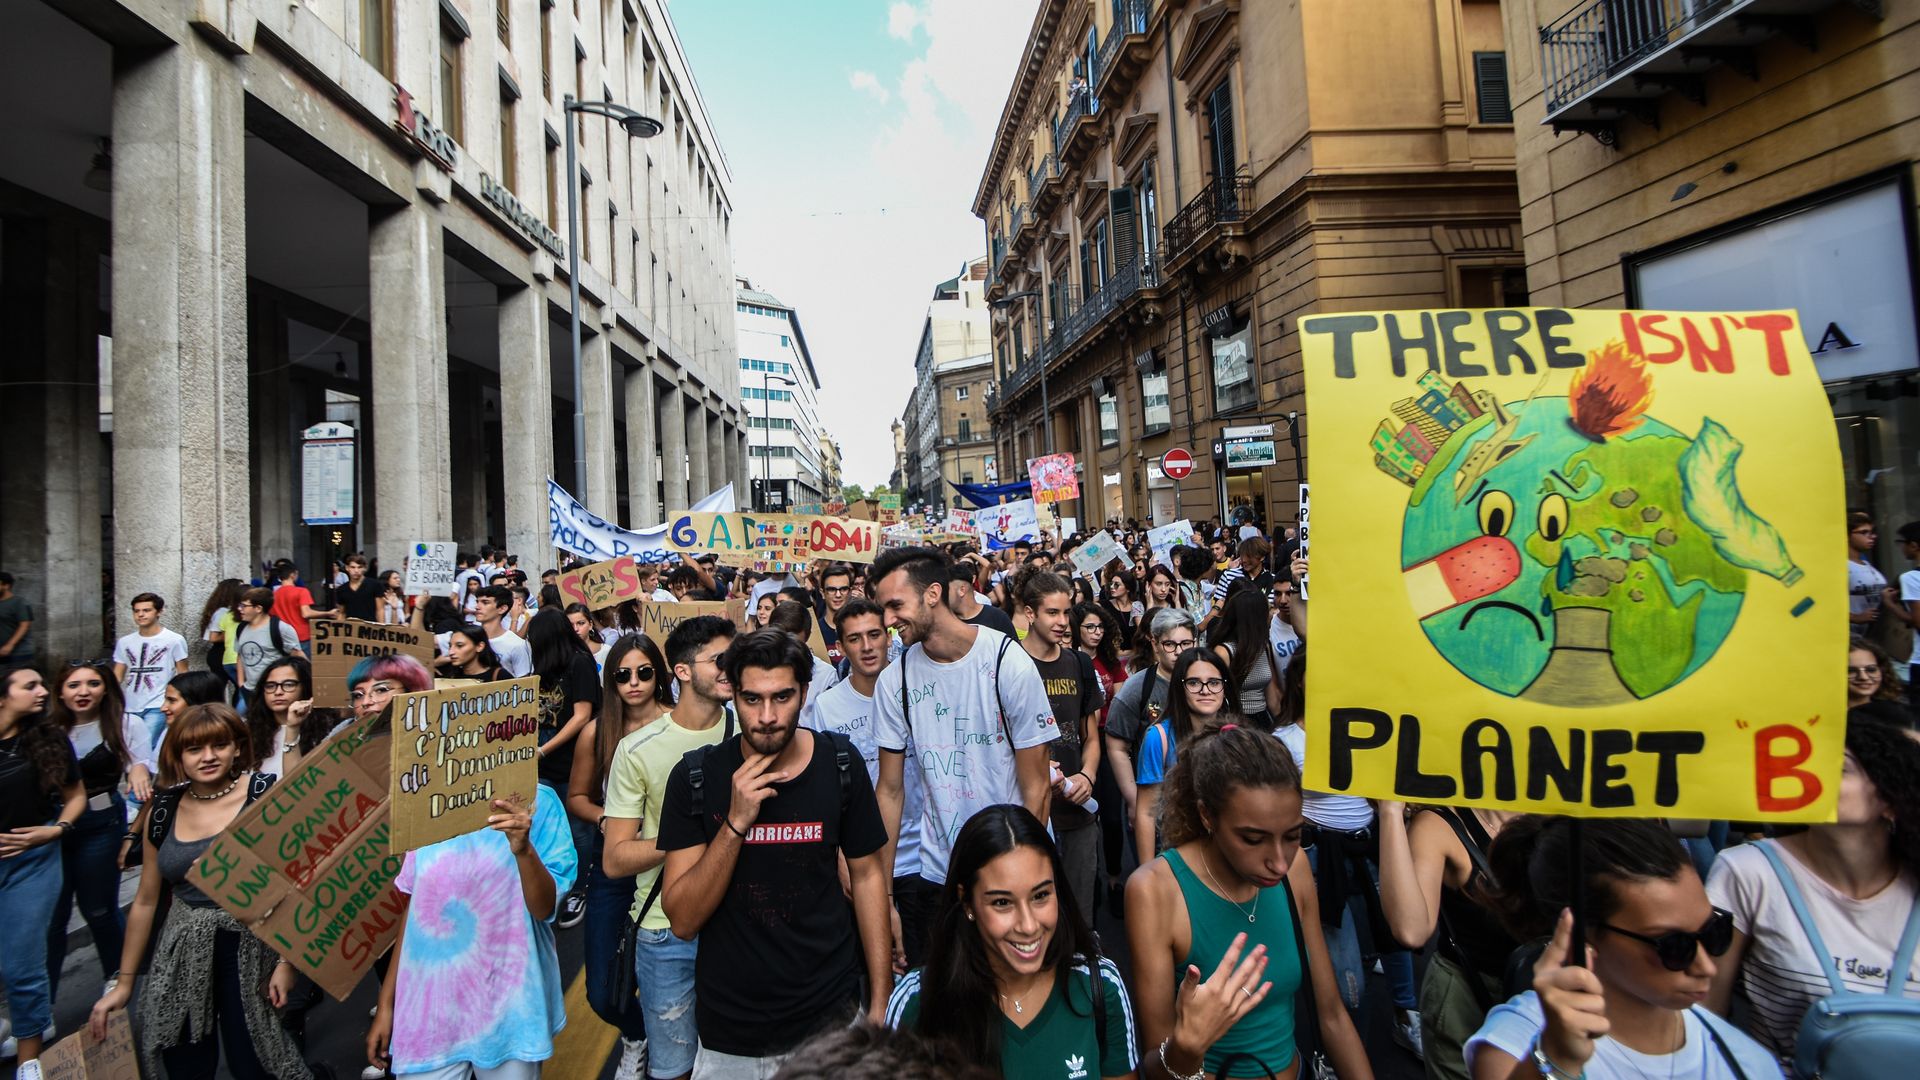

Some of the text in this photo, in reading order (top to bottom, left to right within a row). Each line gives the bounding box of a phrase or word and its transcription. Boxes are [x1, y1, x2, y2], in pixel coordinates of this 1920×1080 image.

[1204, 306, 1230, 327] COLET
[1305, 309, 1794, 378] THERE ISN'T
[410, 559, 453, 571] CATHEDRAL
[423, 572, 454, 584] BURNING
[315, 620, 419, 645] STO MORENDO
[644, 604, 686, 633] MAK
[1046, 679, 1077, 696] ROSES
[436, 684, 535, 735] pianeta
[400, 746, 535, 794] di Damiano
[922, 750, 967, 779] AVE
[1329, 707, 1705, 808] PLANET
[430, 778, 495, 818] David
[201, 842, 241, 890] SE
[232, 827, 264, 849] IL
[261, 765, 326, 826] CLIMA
[745, 825, 822, 841] URRICANE
[227, 779, 381, 909] UNA GRANDE BANCA
[274, 933, 292, 949] I
[341, 887, 411, 971] SALV
[1845, 958, 1885, 979] Love
[1068, 1069, 1087, 1079] adidas
